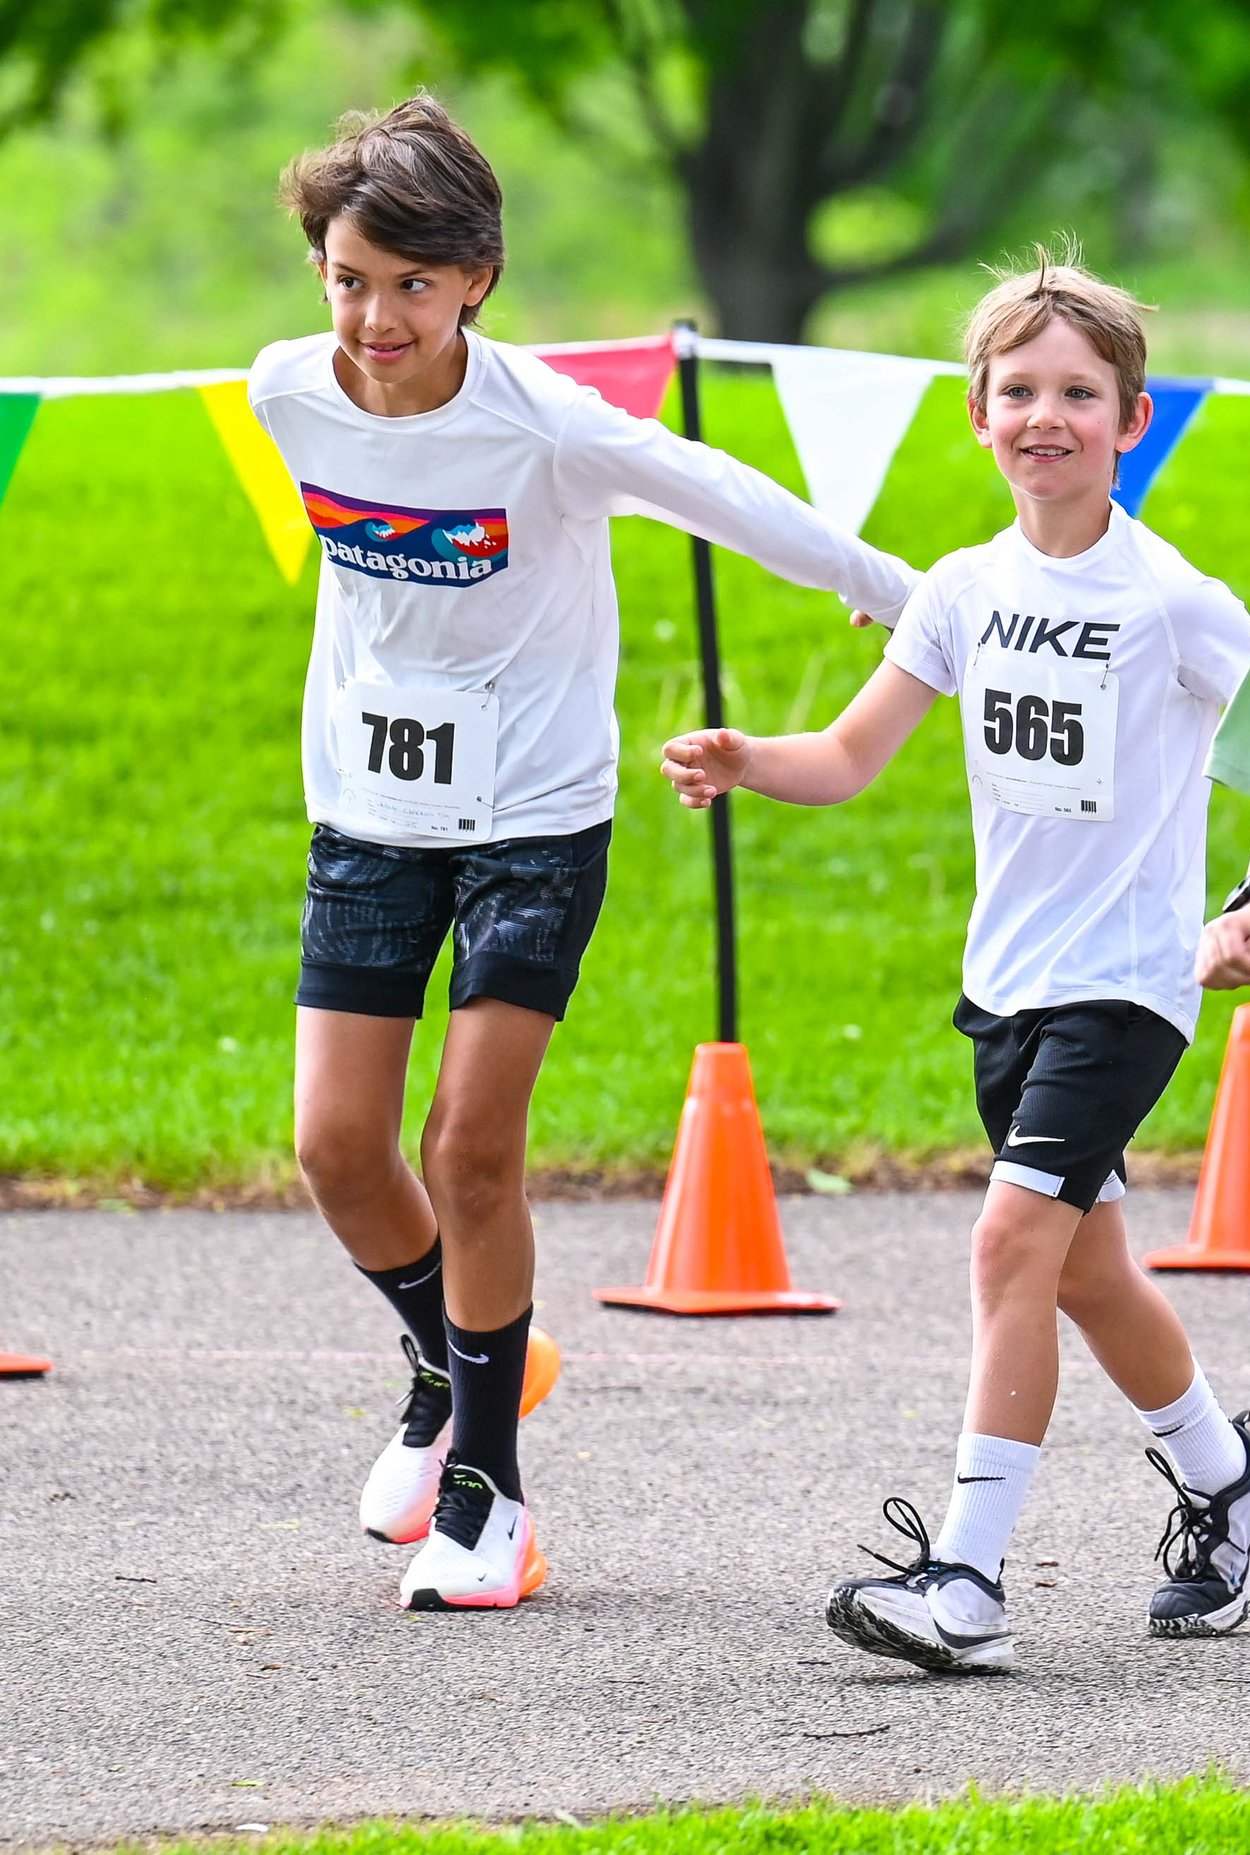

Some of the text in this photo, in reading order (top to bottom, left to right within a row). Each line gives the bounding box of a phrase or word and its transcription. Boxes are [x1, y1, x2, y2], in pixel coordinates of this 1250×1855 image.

[319, 534, 493, 580] patagonia
[981, 610, 1121, 661] NIKE
[361, 711, 455, 785] 781
[983, 688, 1084, 767] 565
